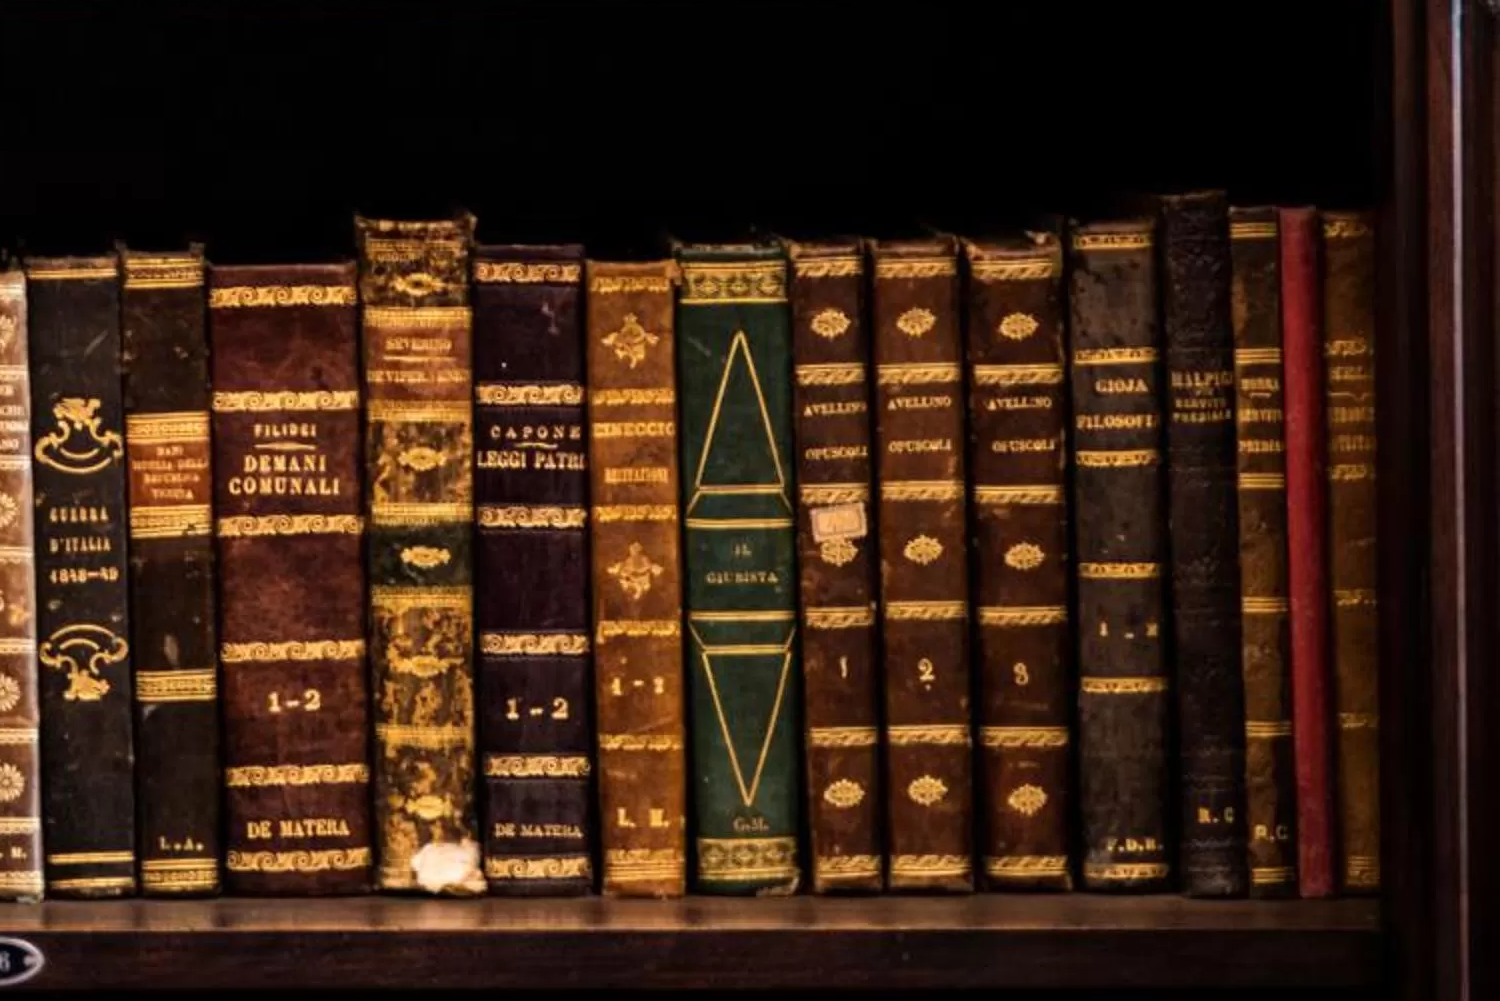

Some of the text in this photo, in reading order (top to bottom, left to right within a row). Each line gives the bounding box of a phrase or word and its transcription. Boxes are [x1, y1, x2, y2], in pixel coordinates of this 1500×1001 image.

[1095, 378, 1148, 393] GIOJA
[888, 396, 952, 409] AVELLINO
[987, 398, 1052, 410] AVELLINO
[254, 423, 317, 438] FILIDEI
[490, 425, 581, 440] CAPONE
[888, 439, 952, 453] OPUSCOLI
[991, 439, 1055, 453] OPUSCOLI
[243, 455, 327, 473] DEMANI
[477, 451, 585, 470] LEGGI PATRI
[228, 476, 340, 496] COMUNALI
[50, 506, 108, 522] GUERRA
[50, 536, 110, 553] D'ITALIA
[839, 657, 848, 679] 1
[918, 658, 935, 682] 2
[248, 818, 349, 839] DE MATERA
[495, 823, 583, 838] DE MATERA
